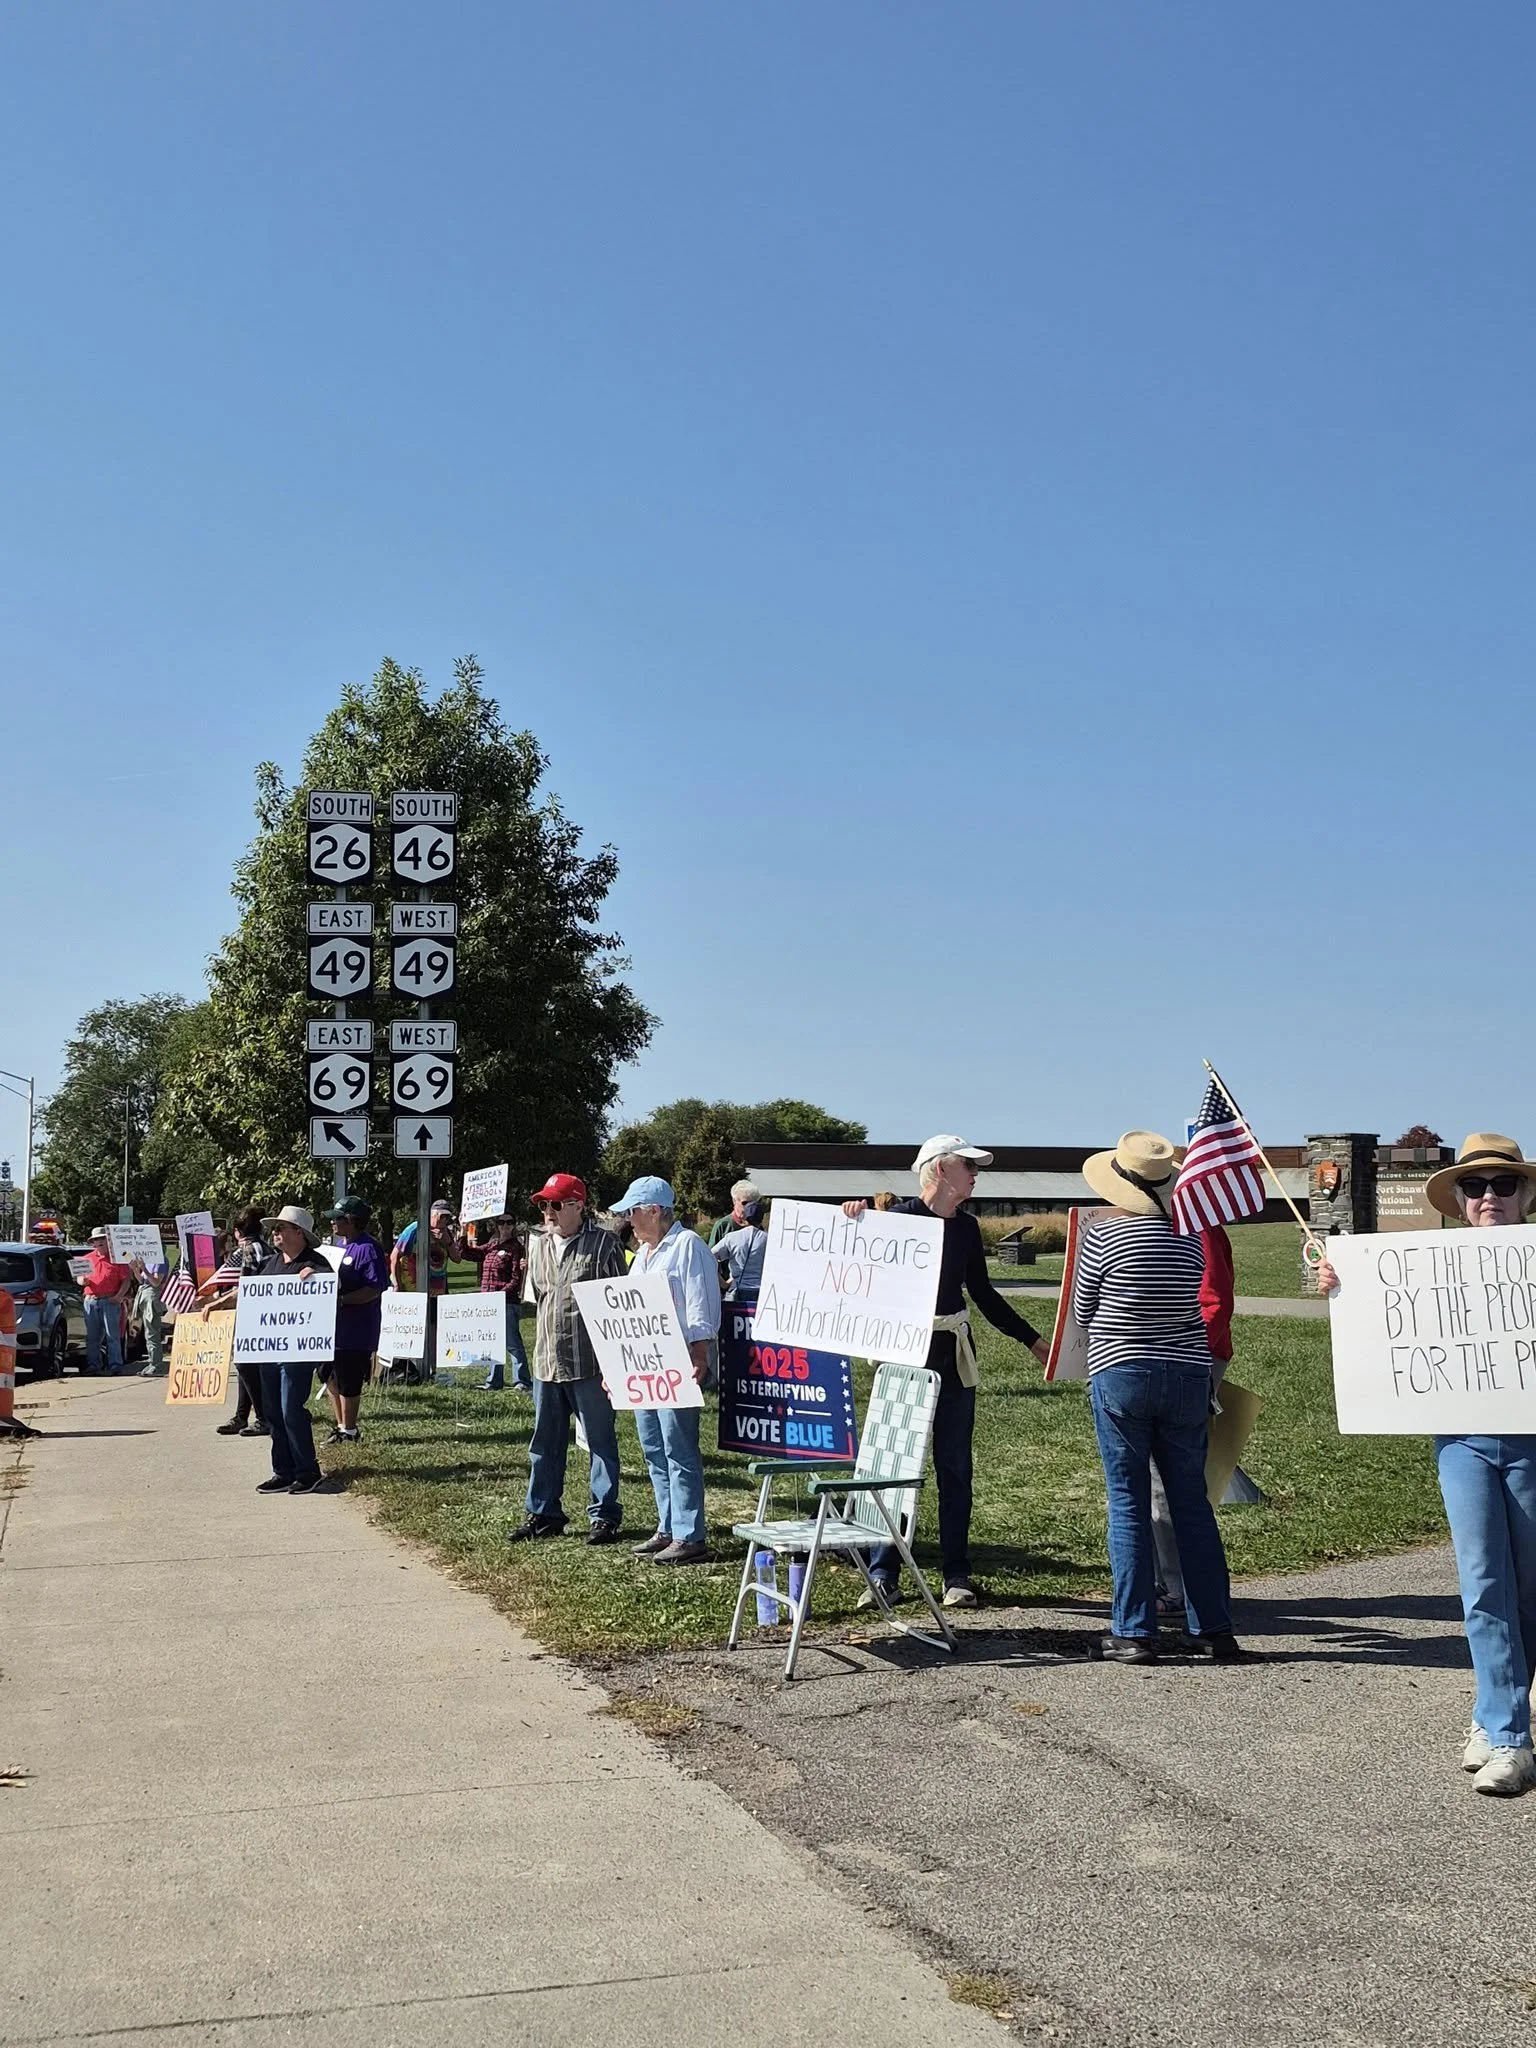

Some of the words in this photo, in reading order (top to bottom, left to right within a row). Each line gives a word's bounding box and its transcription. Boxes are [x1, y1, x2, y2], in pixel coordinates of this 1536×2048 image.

[312, 797, 370, 816] SOUTH
[395, 799, 453, 816] SOUTH
[314, 835, 366, 870] 26
[397, 837, 450, 870] 46
[319, 910, 364, 927] EAST
[400, 910, 448, 928] WEST
[315, 950, 365, 984] 49
[399, 950, 449, 984] 49
[318, 1027, 363, 1045] EAST
[400, 1028, 447, 1045] WEST
[313, 1066, 365, 1100] 69
[397, 1066, 449, 1100] 69
[1376, 1185, 1394, 1194] Fort
[1395, 1184, 1427, 1194] Stanwi
[821, 1260, 884, 1298] NOT
[1378, 1249, 1419, 1286] OF
[1426, 1246, 1469, 1285] THE
[1478, 1245, 1535, 1284] PEOP
[243, 1283, 273, 1297] YOUR
[277, 1280, 335, 1296] DRUGGIST
[605, 1285, 645, 1312] Gun
[260, 1311, 312, 1326] KNOWS!
[387, 1303, 419, 1316] Medicaid
[1385, 1288, 1420, 1339] BY
[1430, 1285, 1478, 1338] THE
[1484, 1283, 1536, 1332] PEOP
[445, 1331, 474, 1343] National
[477, 1329, 497, 1341] Parks
[594, 1314, 671, 1340] VIOLENCE
[236, 1337, 289, 1352] VACCINES
[297, 1336, 332, 1351] WORK
[621, 1343, 663, 1372] Must
[177, 1351, 193, 1366] WILL
[196, 1351, 213, 1365] NOT
[215, 1351, 224, 1364] BE
[749, 1346, 809, 1380] 2025
[1391, 1346, 1453, 1397] FOR
[1455, 1341, 1505, 1391] THE
[172, 1368, 221, 1399] SILENCED
[627, 1369, 682, 1403] STOP
[737, 1379, 747, 1394] IS
[751, 1381, 826, 1402] TERRIFYING
[736, 1416, 780, 1443] VOTE
[786, 1422, 834, 1448] BLUE
